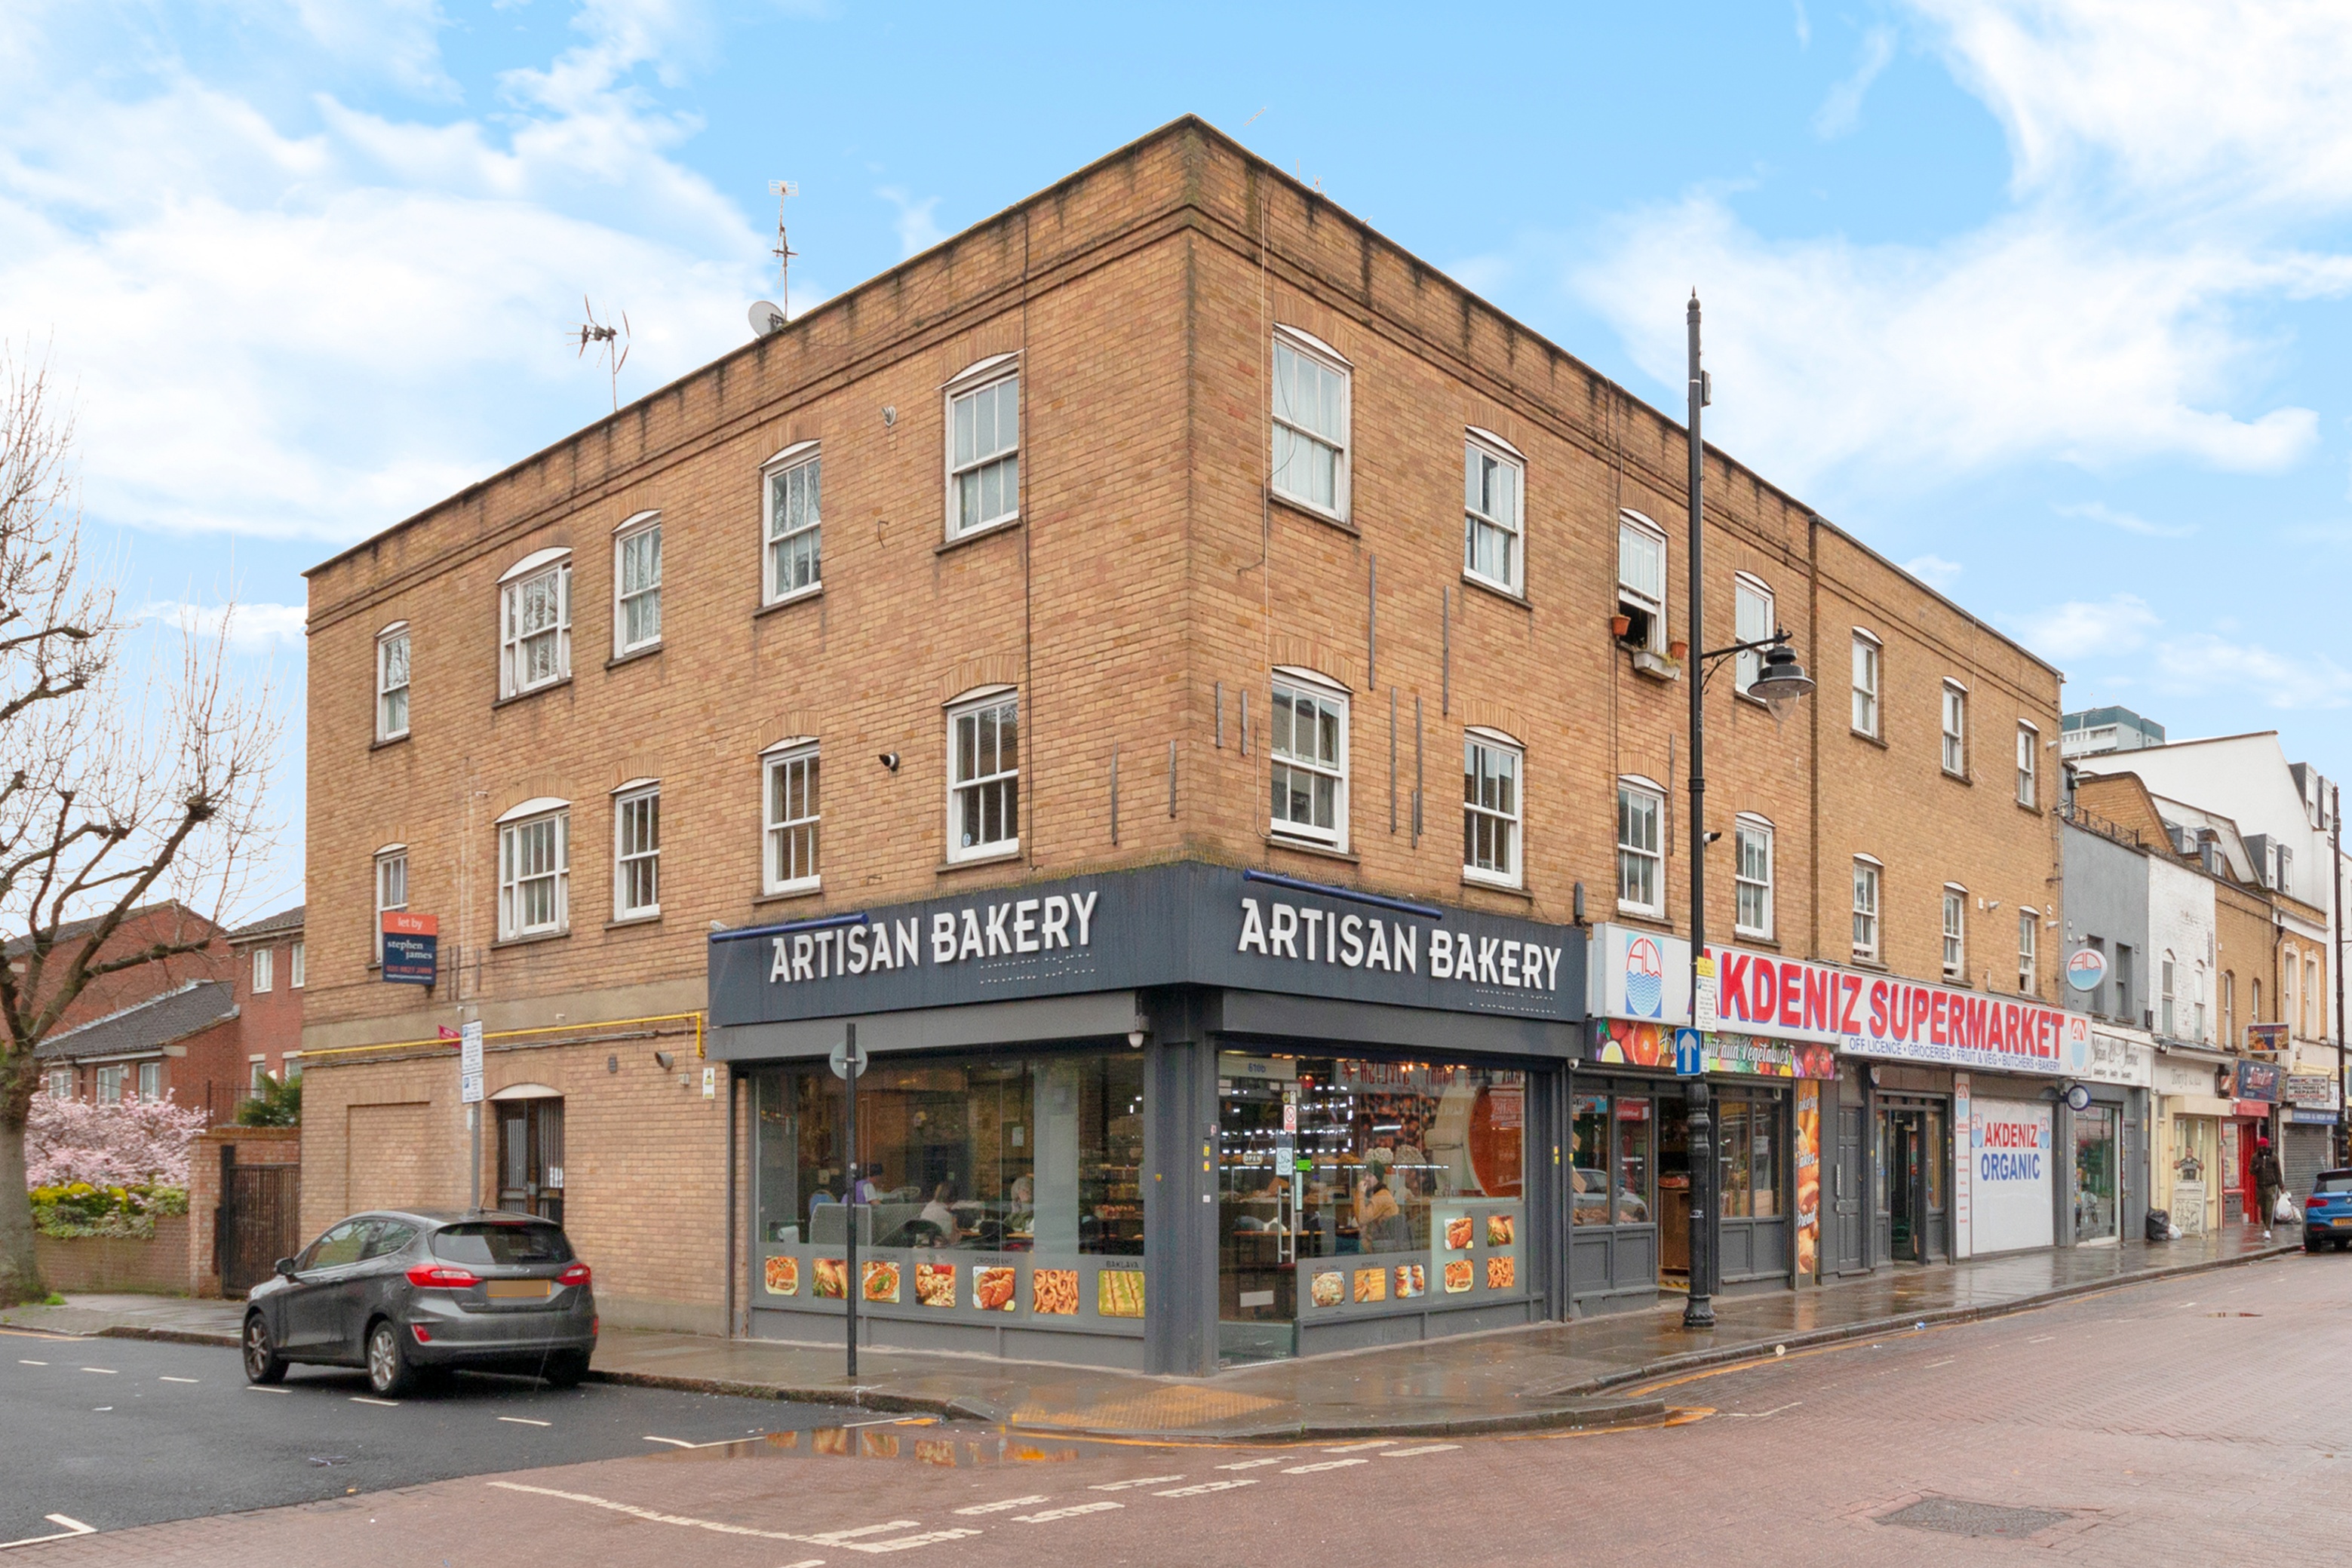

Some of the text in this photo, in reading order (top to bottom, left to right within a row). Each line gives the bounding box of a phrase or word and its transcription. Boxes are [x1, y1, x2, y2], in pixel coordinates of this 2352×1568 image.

[398, 916, 422, 931] let by
[770, 891, 1098, 983] ARTISAN BAKERY
[387, 940, 424, 951] stephen
[406, 949, 433, 959] james
[1238, 898, 1561, 991] ARTISAN BAKERY
[1687, 947, 1862, 1036] KDENIZ
[1868, 980, 2065, 1059] SUPERMARKET
[1703, 1038, 1721, 1060] uit
[1721, 1038, 1739, 1060] and
[1742, 1036, 1789, 1071] Vegetables
[1849, 1037, 2061, 1072] OFF LICENCE GROCERIES FRUIT & VEG BUTCHERS BAKERY
[1798, 1093, 1818, 1115] akery
[1984, 1122, 2038, 1148] AKDENIZ
[1981, 1153, 2040, 1181] ORGANIC
[1106, 1260, 1139, 1269] BAKLAVA
